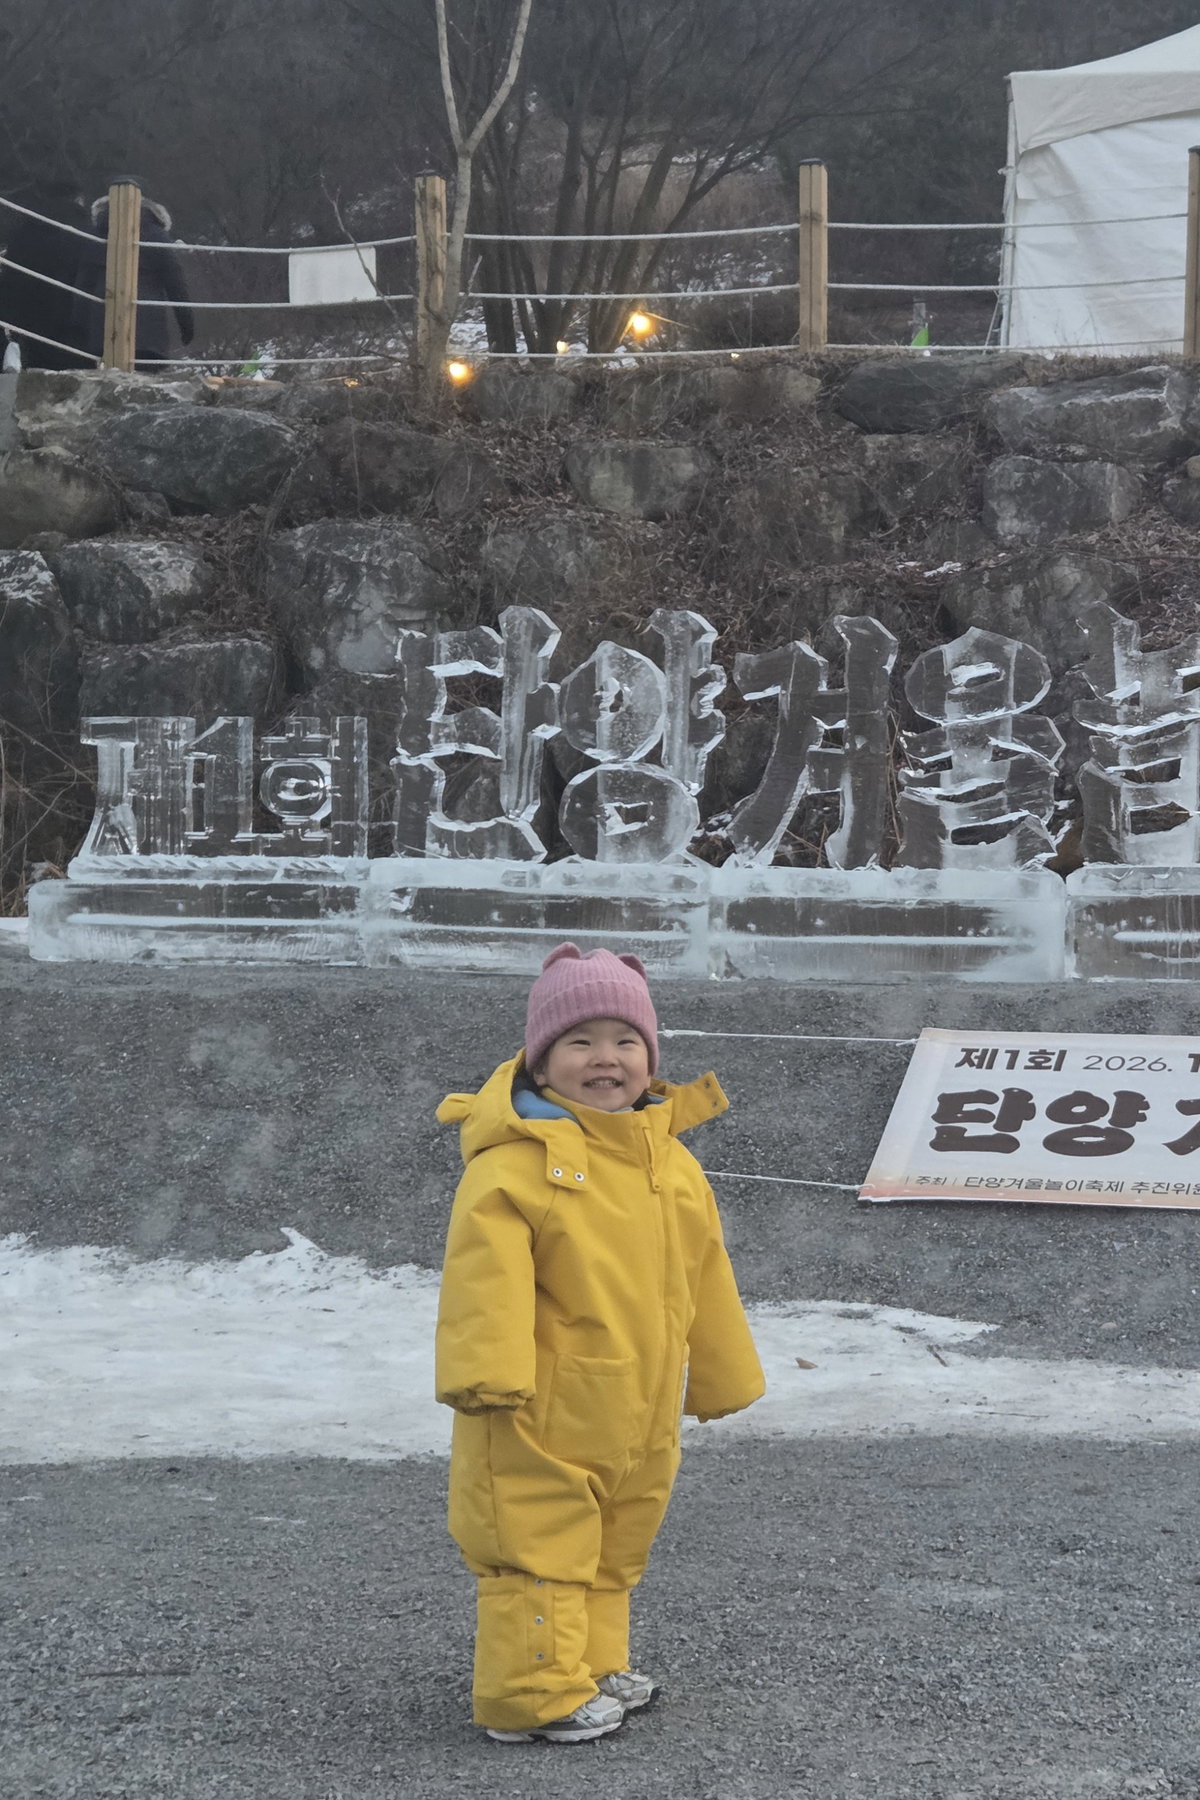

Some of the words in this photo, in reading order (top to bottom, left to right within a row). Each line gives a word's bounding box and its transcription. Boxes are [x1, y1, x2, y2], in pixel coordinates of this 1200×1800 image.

[954, 1047, 1066, 1072] 제1회
[1082, 1055, 1173, 1072] 2026.
[929, 1086, 1151, 1158] 단양
[914, 1175, 947, 1187] 주최
[963, 1175, 1125, 1194] 단양겨울놀이축제
